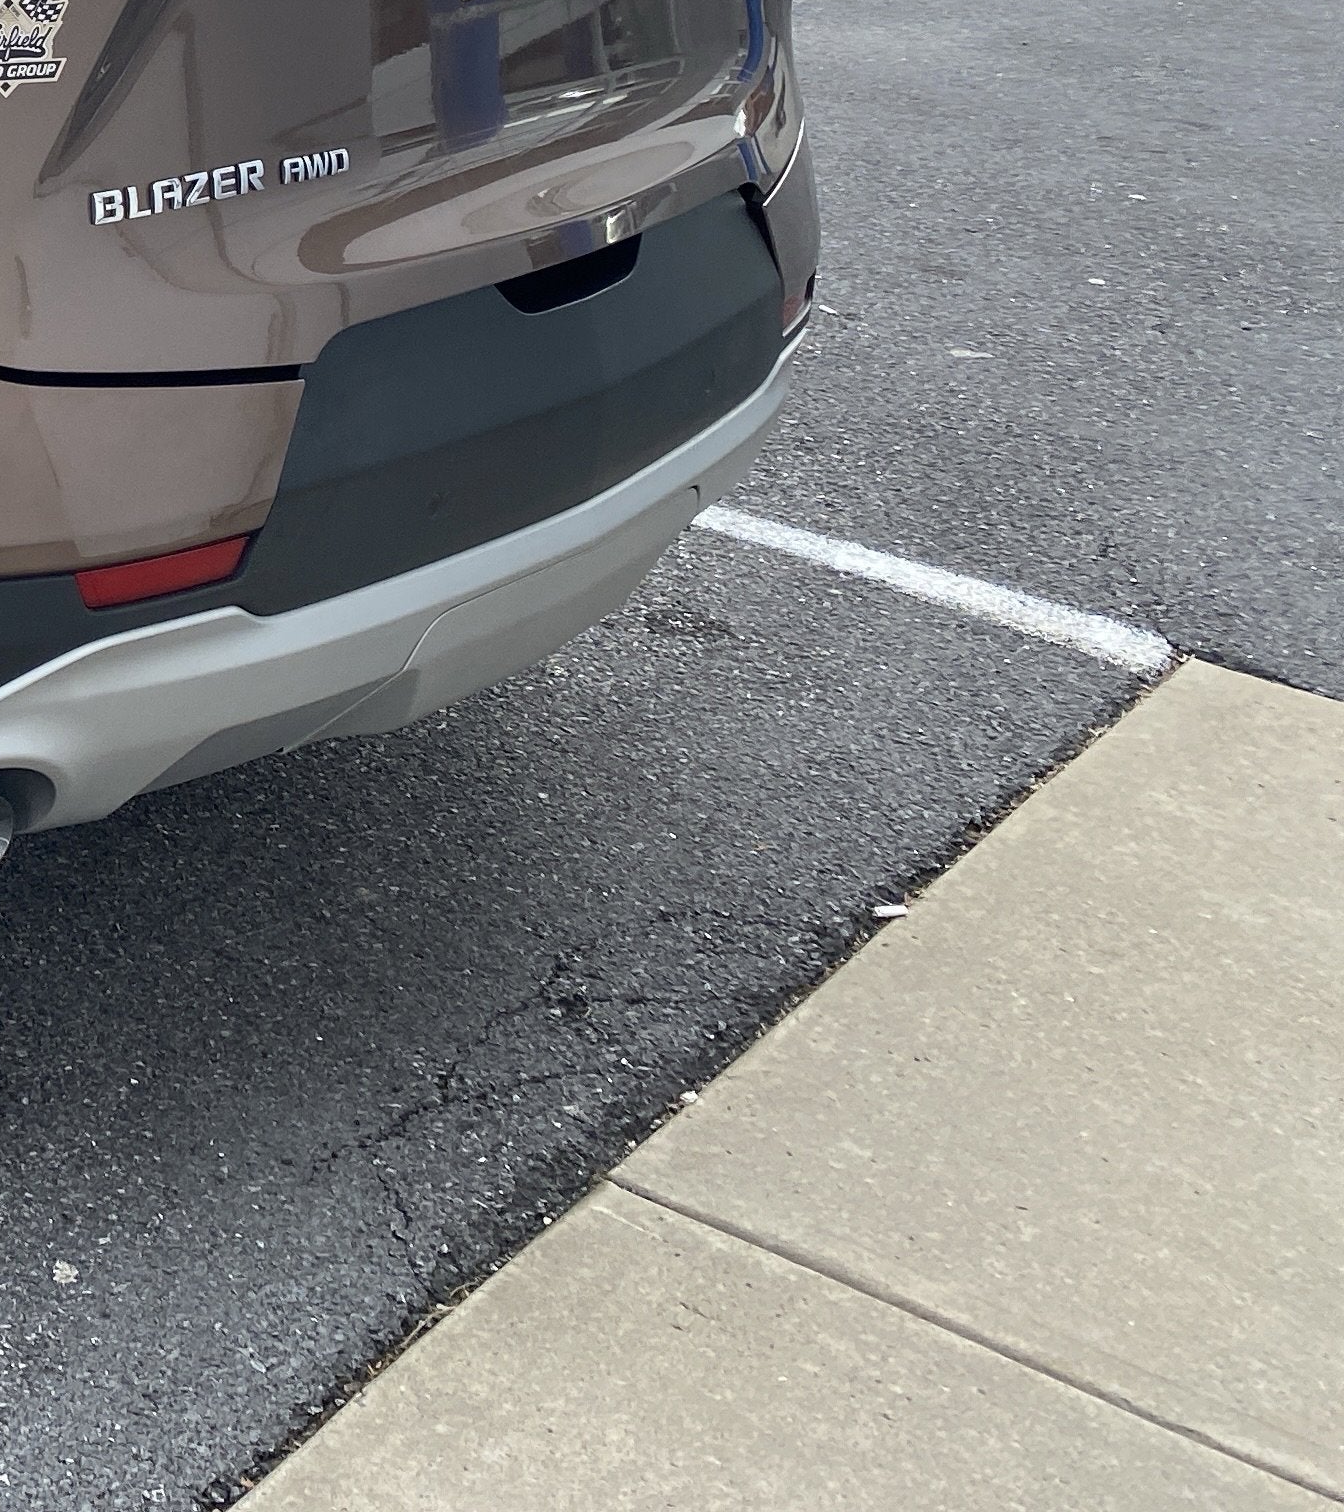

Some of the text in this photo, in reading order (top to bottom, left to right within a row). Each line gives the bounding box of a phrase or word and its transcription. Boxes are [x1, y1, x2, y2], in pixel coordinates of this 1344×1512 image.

[6, 63, 57, 78] GROUP
[90, 147, 350, 226] BLAZER AWD
